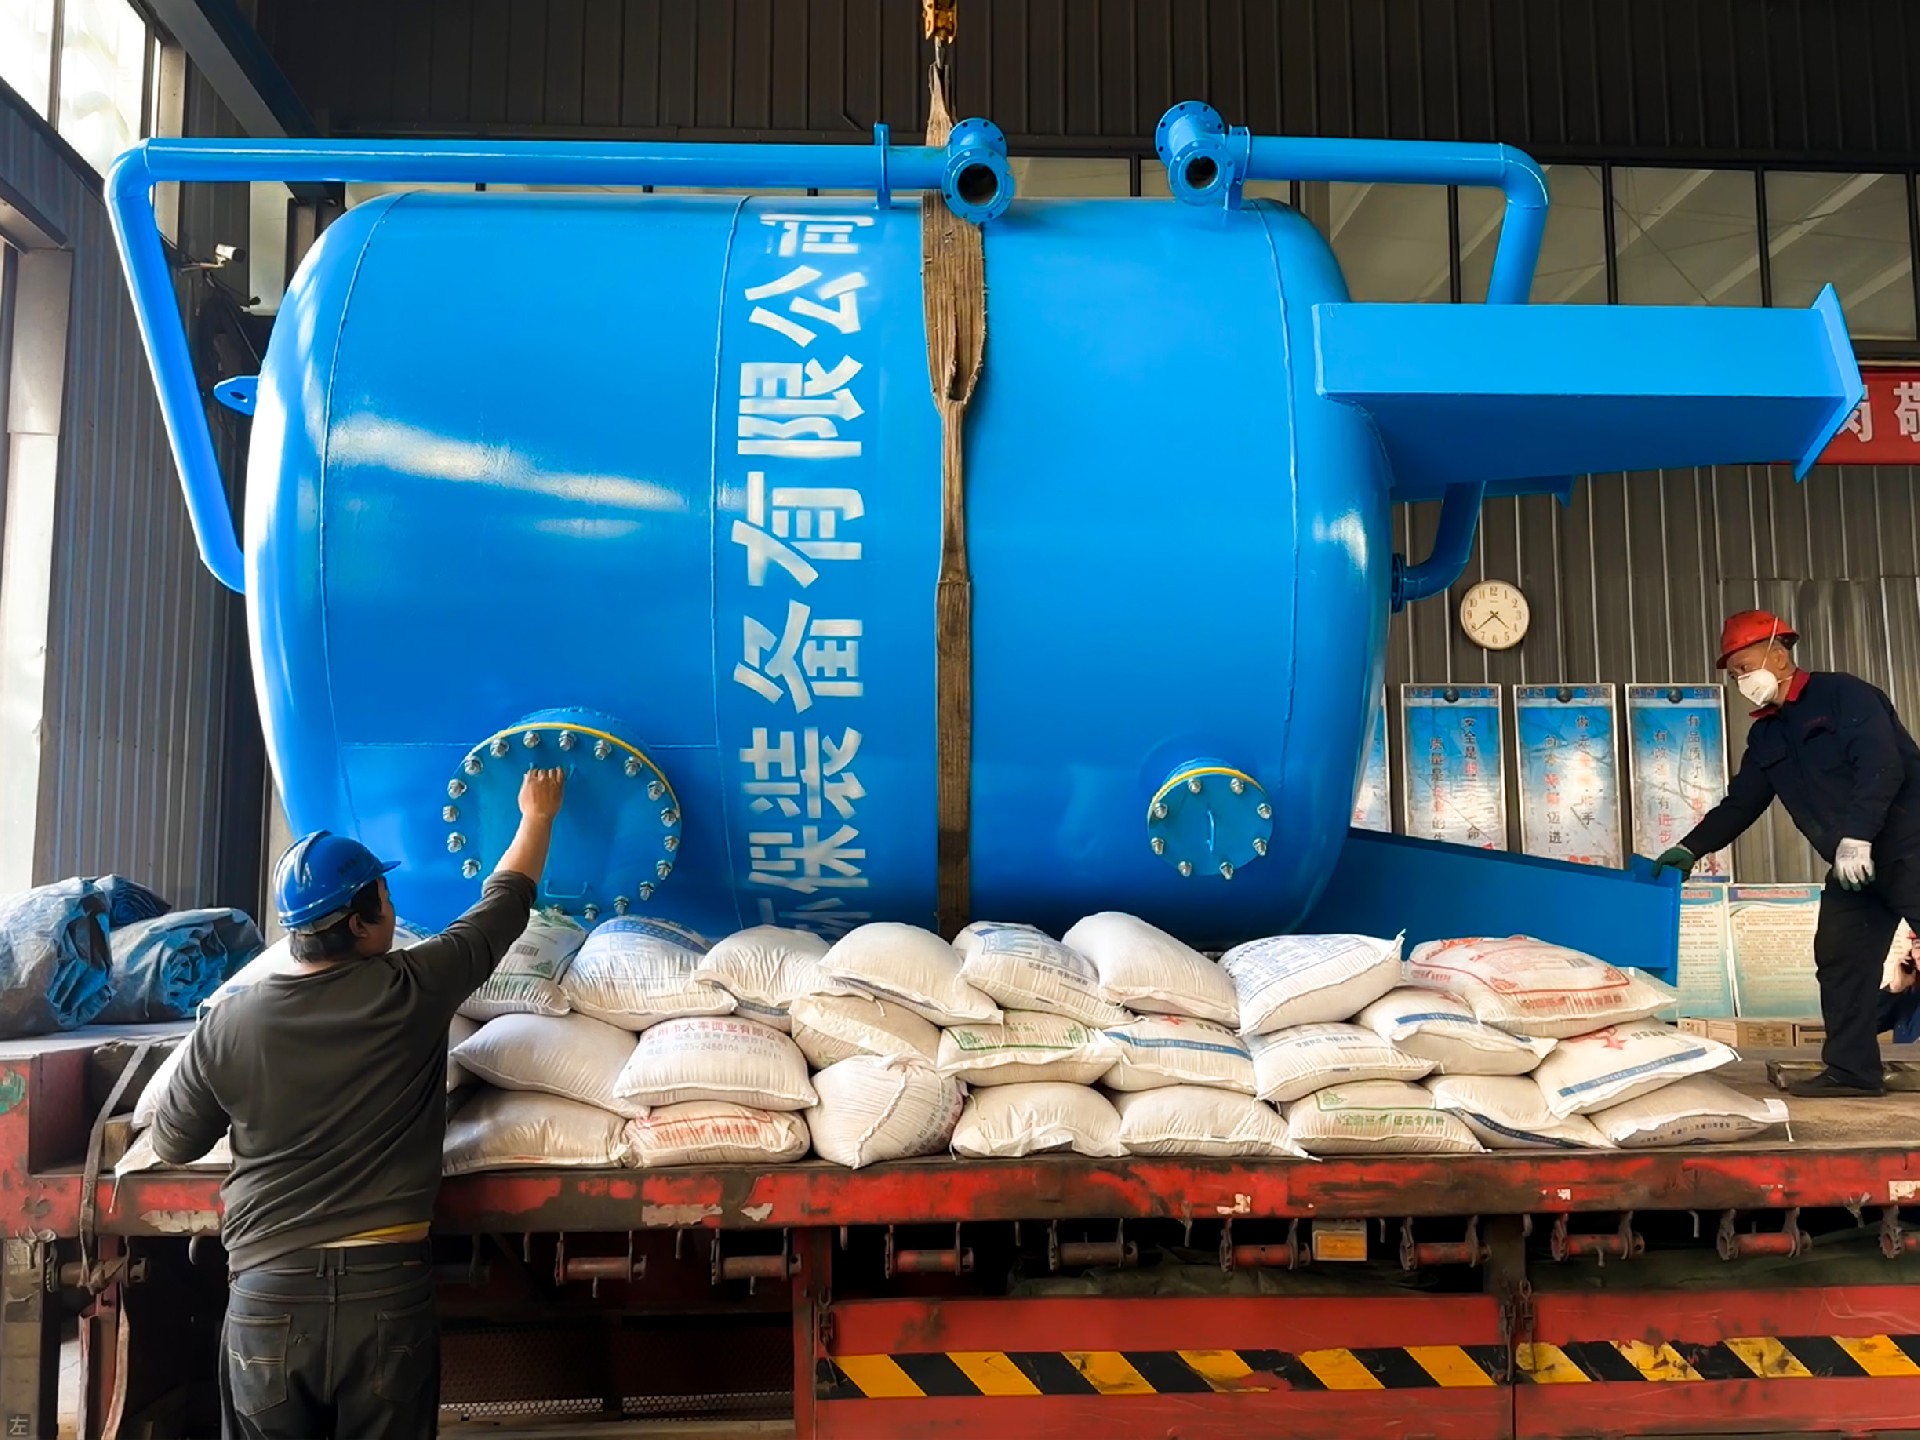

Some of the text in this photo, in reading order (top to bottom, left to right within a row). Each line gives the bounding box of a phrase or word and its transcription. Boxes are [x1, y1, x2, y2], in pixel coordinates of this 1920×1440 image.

[1489, 586, 1498, 596] 12
[1469, 599, 1477, 607] 10
[10, 1415, 29, 1436] 左
